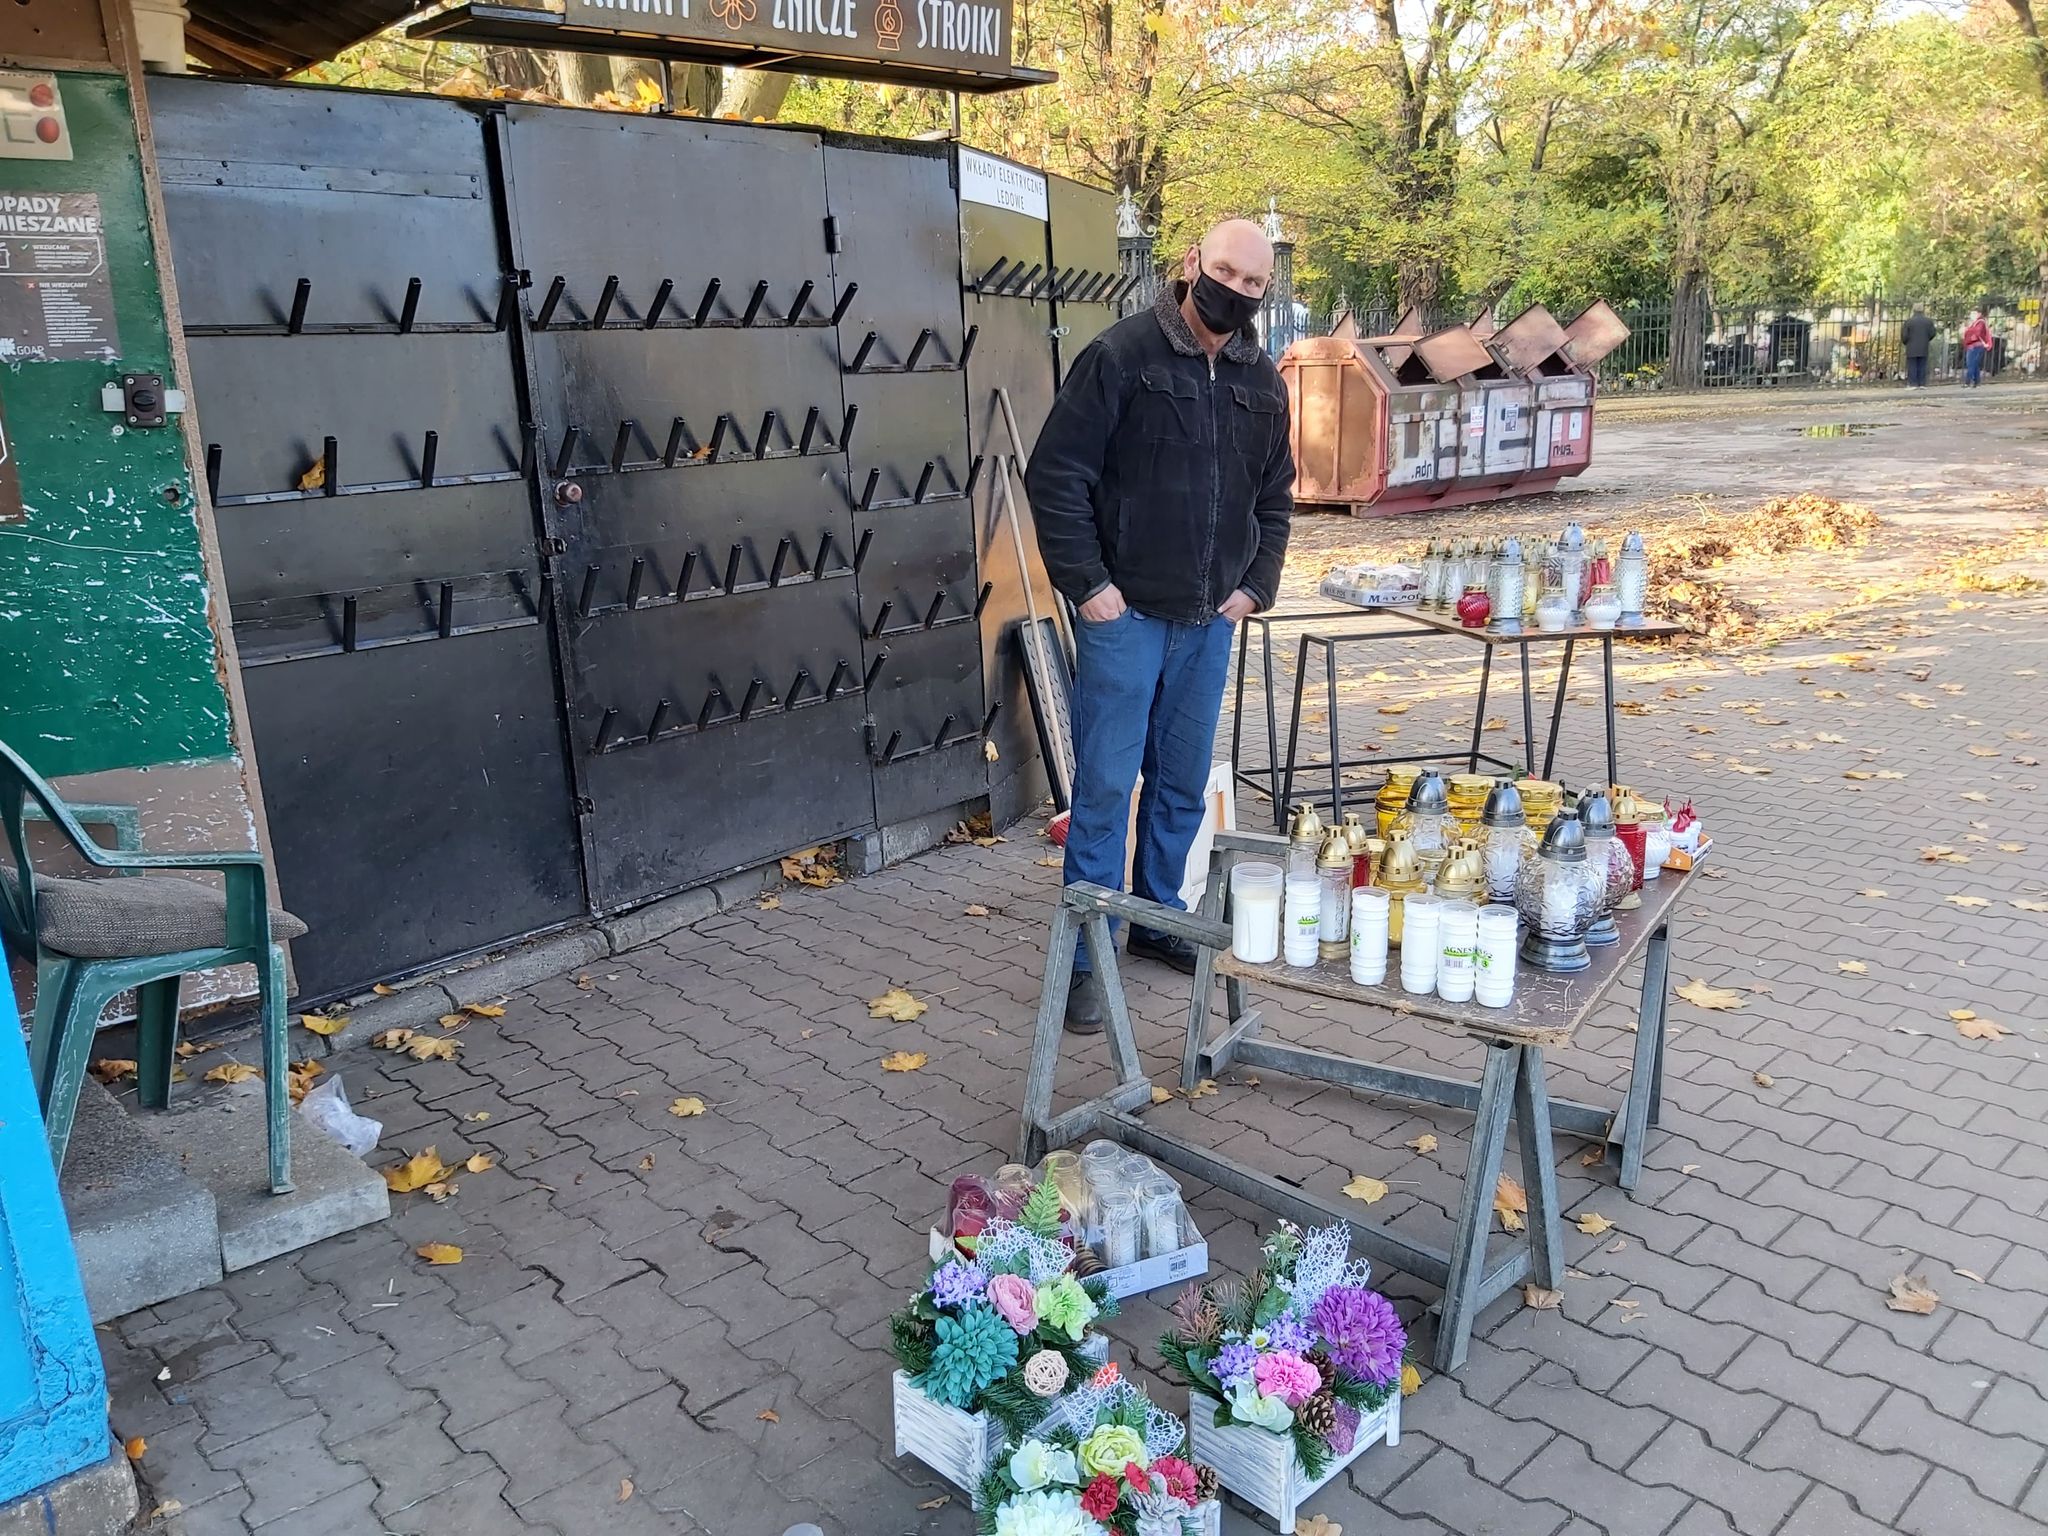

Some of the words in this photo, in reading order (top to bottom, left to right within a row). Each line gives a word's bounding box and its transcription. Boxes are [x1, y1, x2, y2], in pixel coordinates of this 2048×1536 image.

[772, 0, 858, 39] ZNICZE
[916, 0, 1001, 57] STROIKI
[965, 156, 997, 179] WKŁADY
[999, 167, 1043, 196] ELEKTRYCZNE
[0, 196, 61, 214] PADY
[996, 188, 1025, 211] LEDOWE
